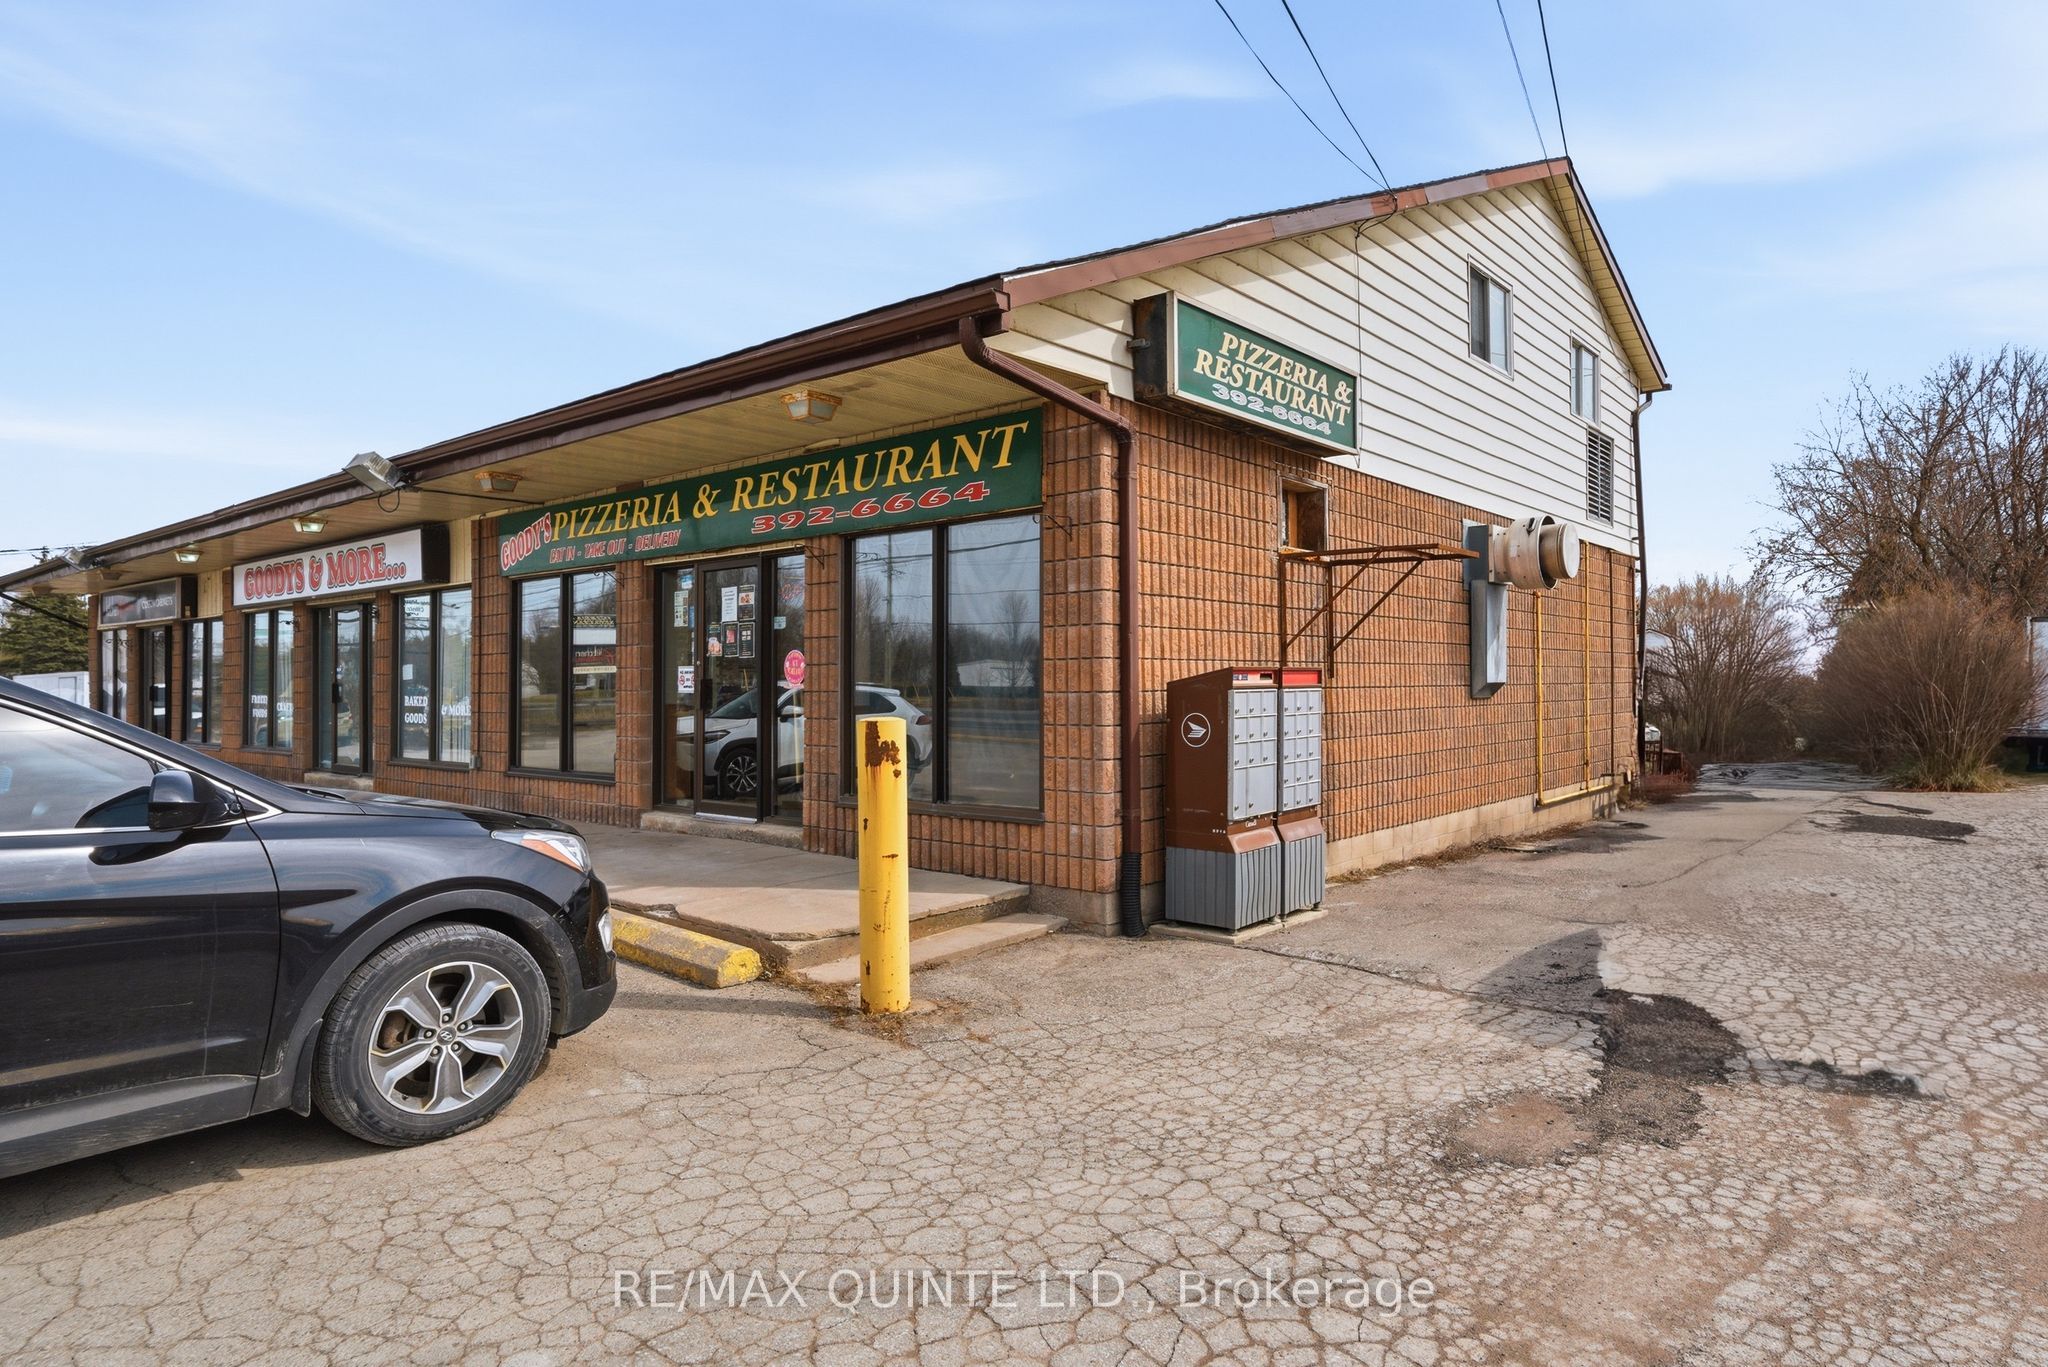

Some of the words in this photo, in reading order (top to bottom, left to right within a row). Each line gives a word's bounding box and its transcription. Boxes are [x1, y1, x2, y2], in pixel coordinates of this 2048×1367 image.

[1193, 348, 1351, 427] RESTAURANT
[1219, 332, 1329, 397] PIZZERIA
[1334, 380, 1353, 404] &
[1212, 383, 1332, 436] 392-6664
[500, 511, 552, 571] GOODY'S
[551, 494, 682, 542] PIZZERIA
[692, 483, 722, 519] &
[729, 420, 1030, 513] RESTAURANT
[751, 480, 991, 536] 392-6664
[550, 547, 566, 564] EAT
[565, 545, 576, 562] IN
[584, 541, 607, 559] TAKE
[607, 537, 627, 556] OUT
[634, 528, 682, 552] DELIVERY
[244, 558, 305, 600] GOODYS
[308, 555, 324, 591] &
[404, 695, 428, 707] BAKED
[404, 712, 428, 724] GOODS
[448, 704, 472, 716] MORE
